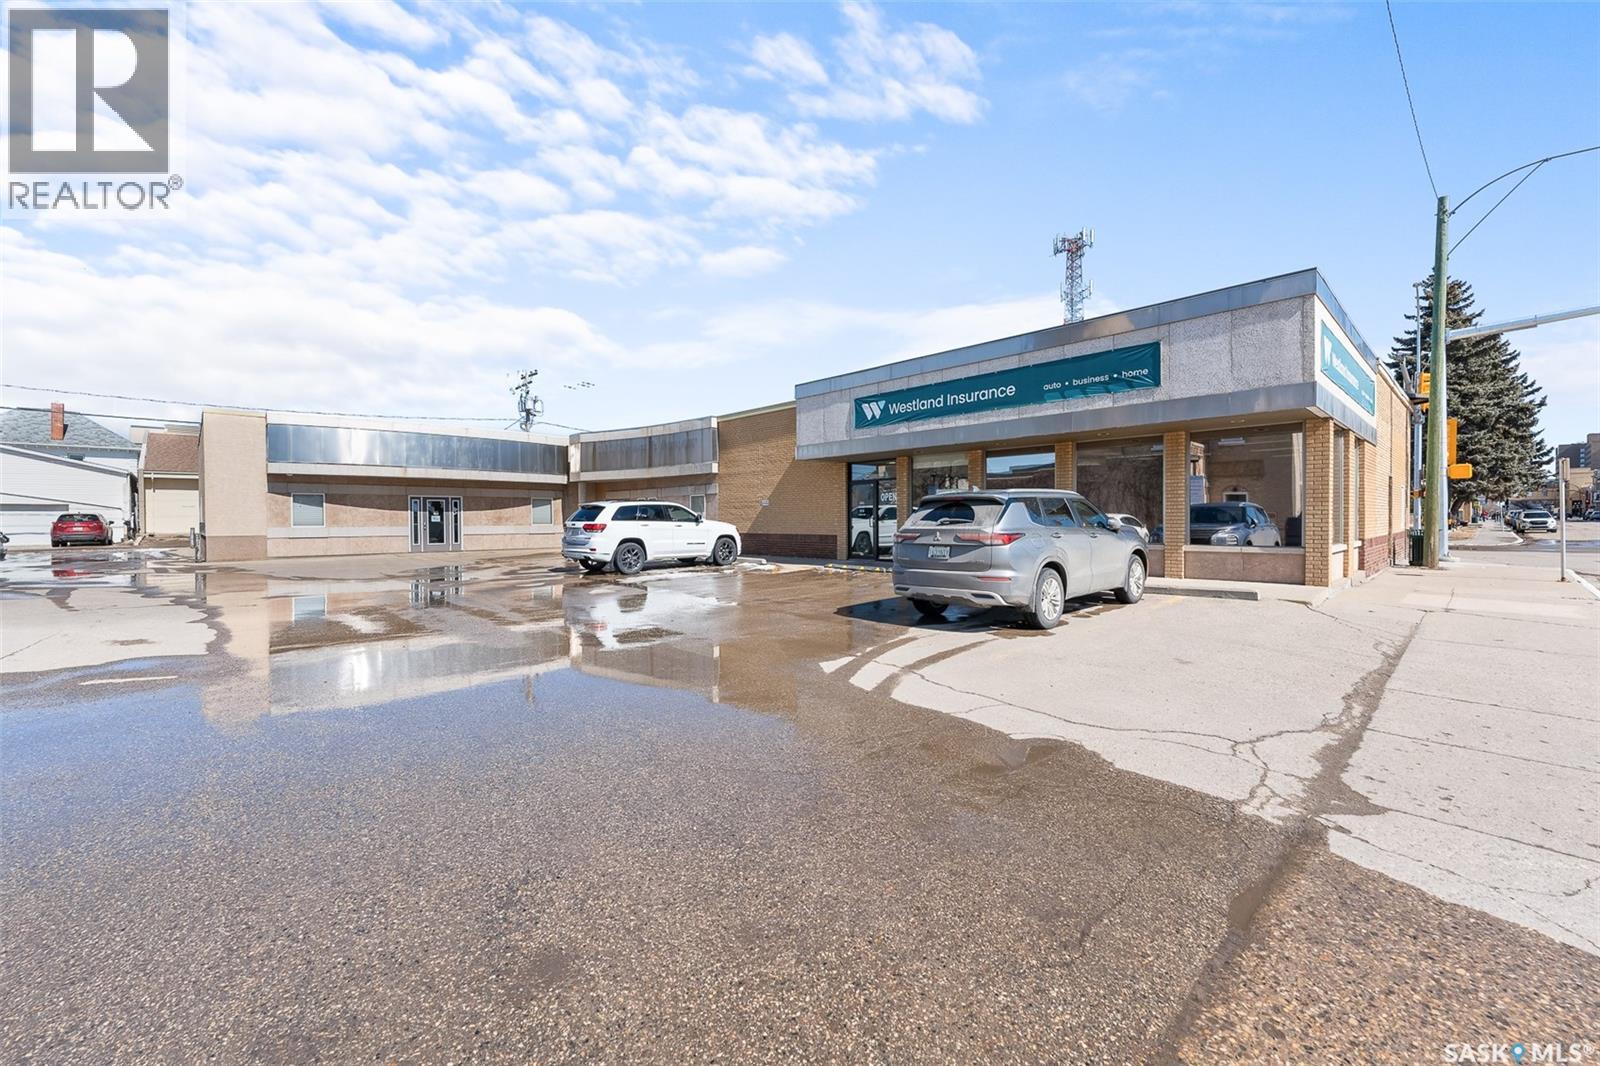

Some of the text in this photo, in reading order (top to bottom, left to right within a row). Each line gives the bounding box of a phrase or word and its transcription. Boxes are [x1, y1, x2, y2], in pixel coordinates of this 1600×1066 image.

[1043, 368, 1149, 391] auto business home
[888, 394, 944, 415] Westland
[946, 384, 1016, 406] Insurance
[880, 492, 897, 502] OPEN
